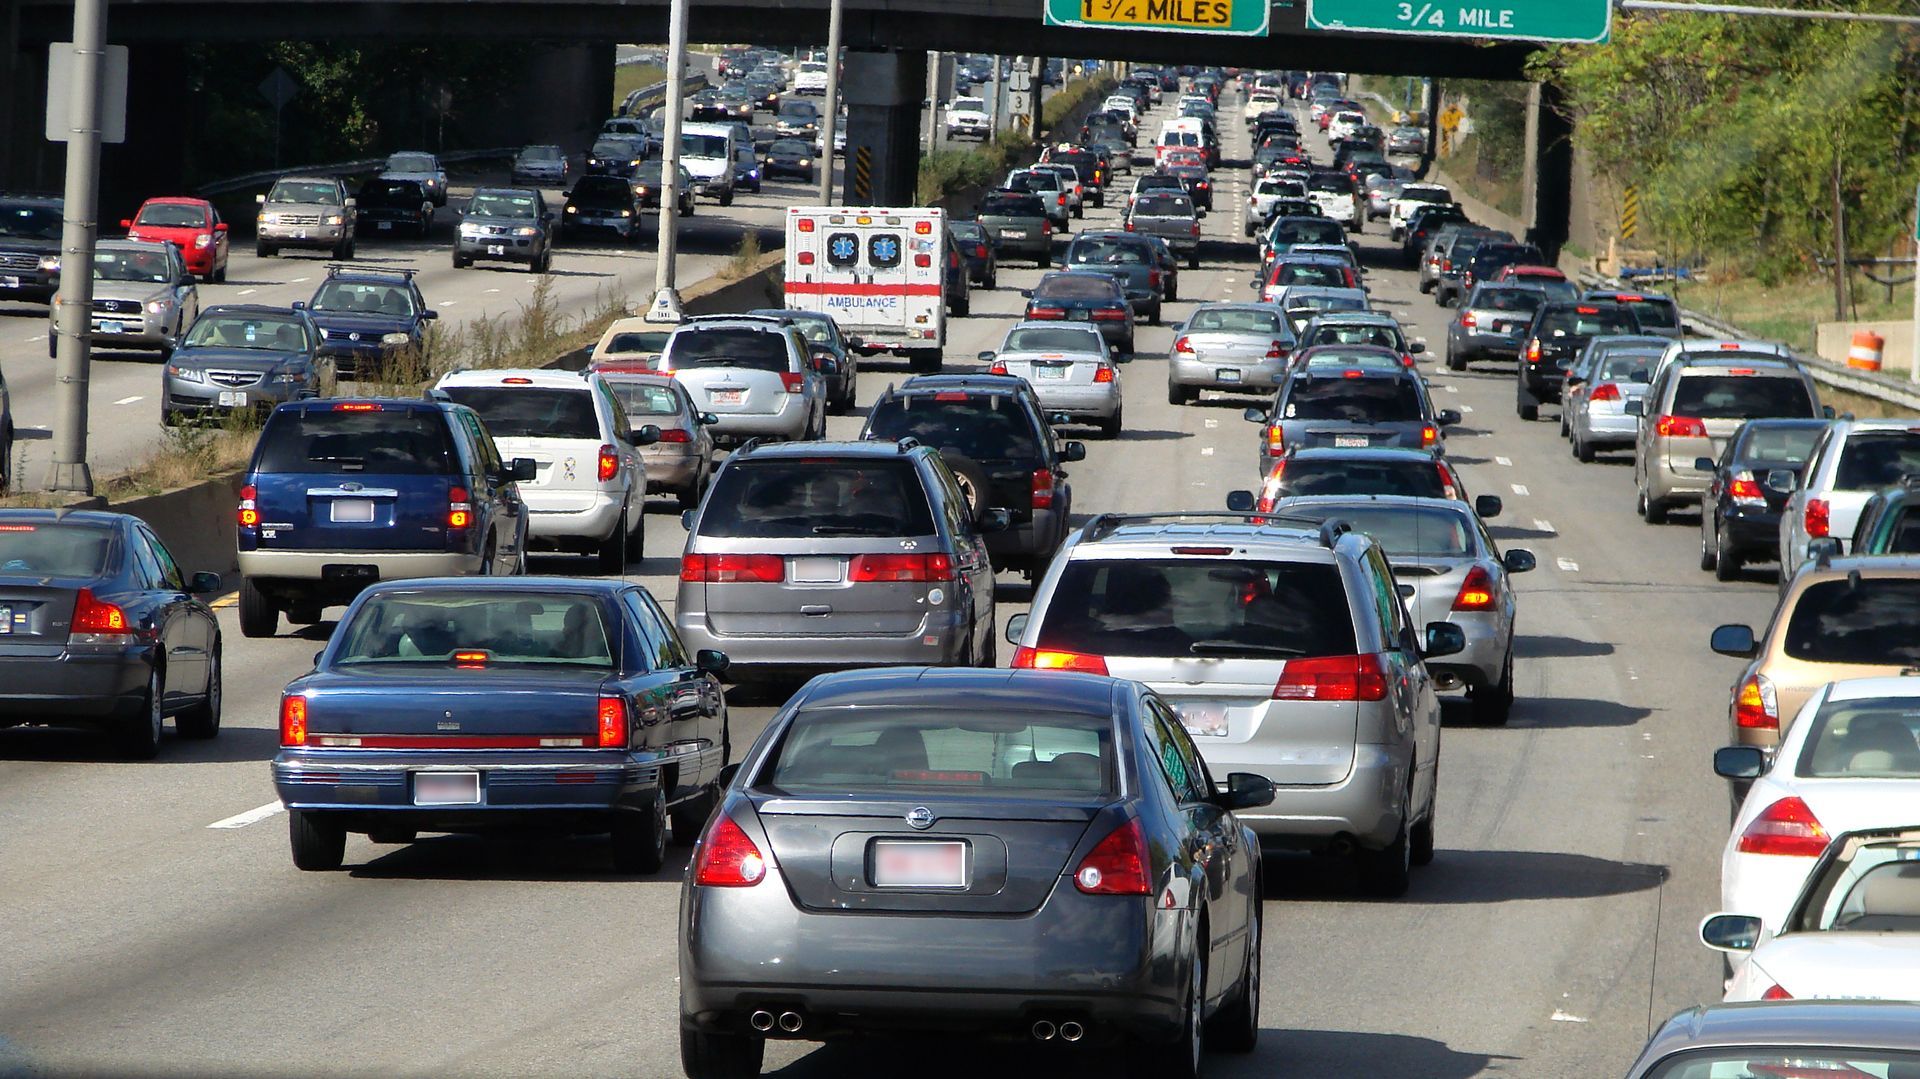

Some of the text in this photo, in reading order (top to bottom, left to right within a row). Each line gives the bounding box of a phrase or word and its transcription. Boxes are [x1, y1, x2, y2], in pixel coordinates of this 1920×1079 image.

[1084, 0, 1228, 23] 1 3/4 MILES
[1397, 2, 1514, 28] 3/4 MILE
[1015, 96, 1022, 109] 3
[827, 296, 897, 308] AMBULANCE
